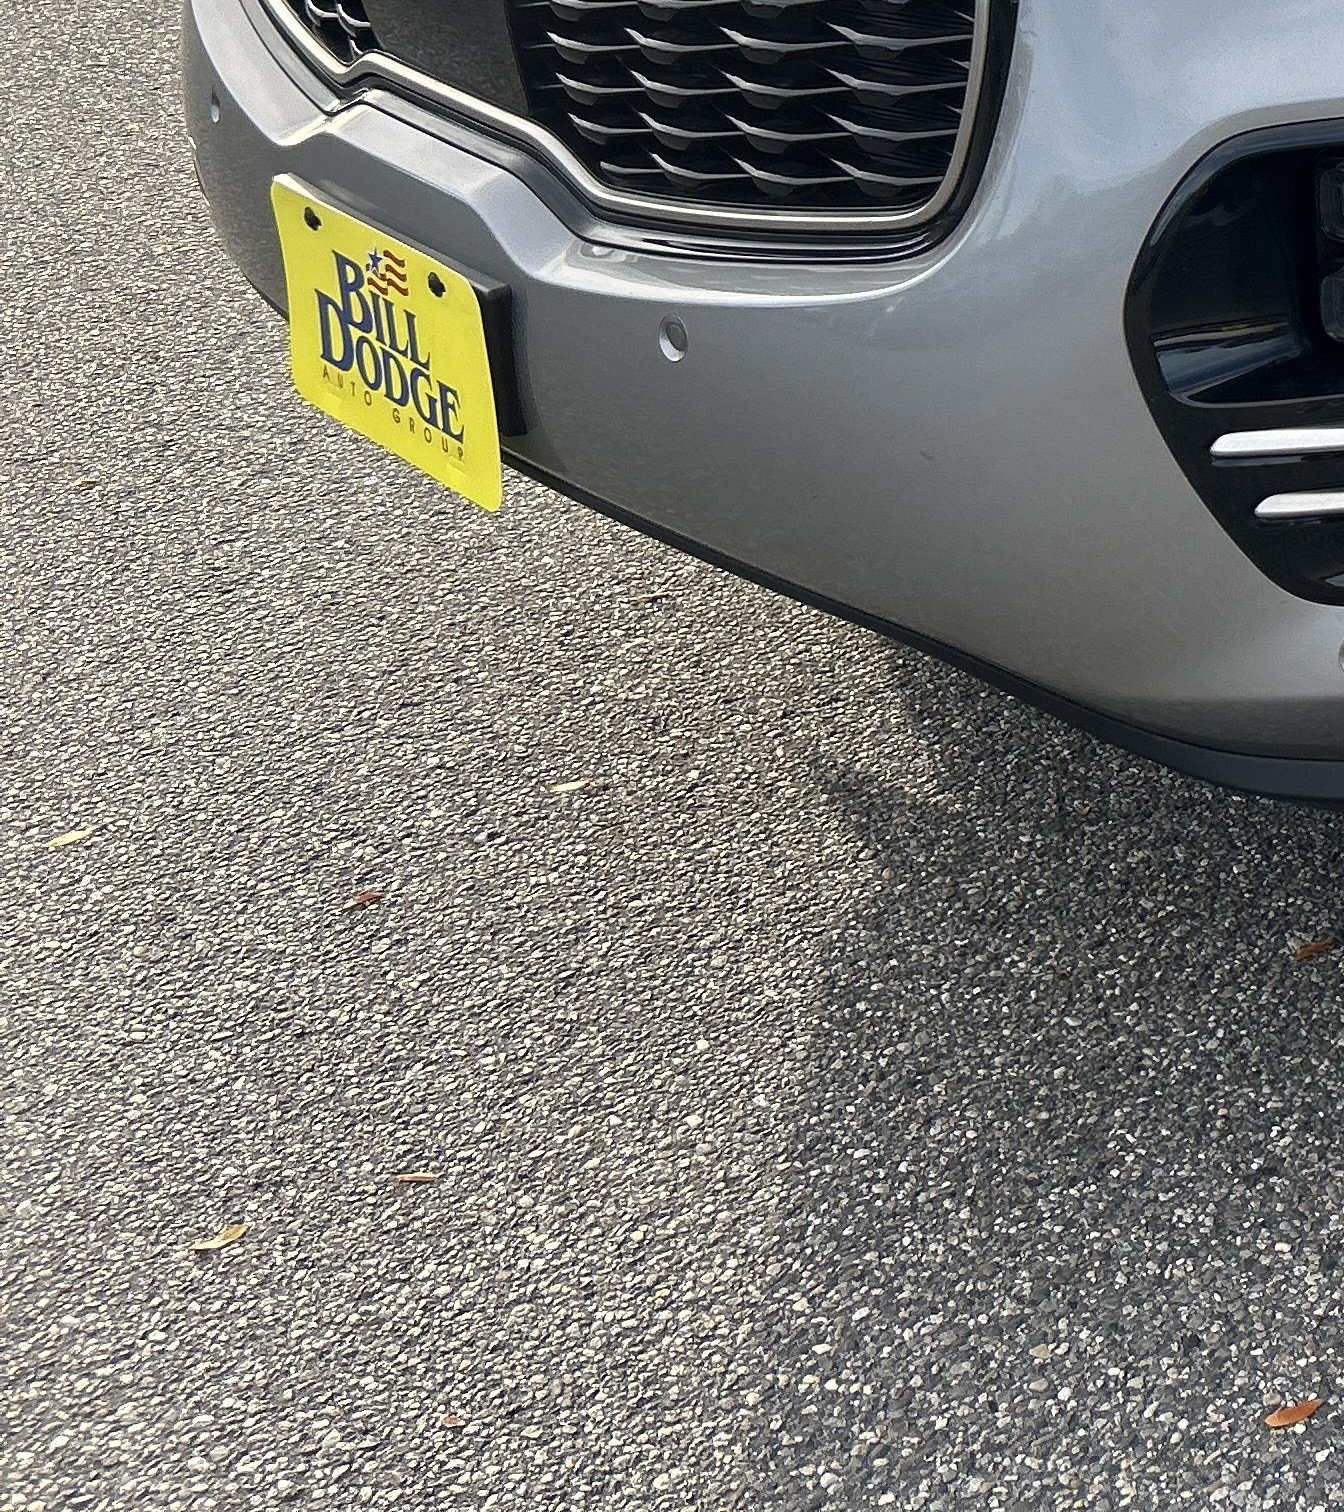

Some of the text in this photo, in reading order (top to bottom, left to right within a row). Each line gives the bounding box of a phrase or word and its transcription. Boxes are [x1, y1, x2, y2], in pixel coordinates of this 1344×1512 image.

[314, 287, 465, 444] DODGE
[332, 248, 431, 371] BILL
[322, 364, 465, 461] AUTO GROUP
